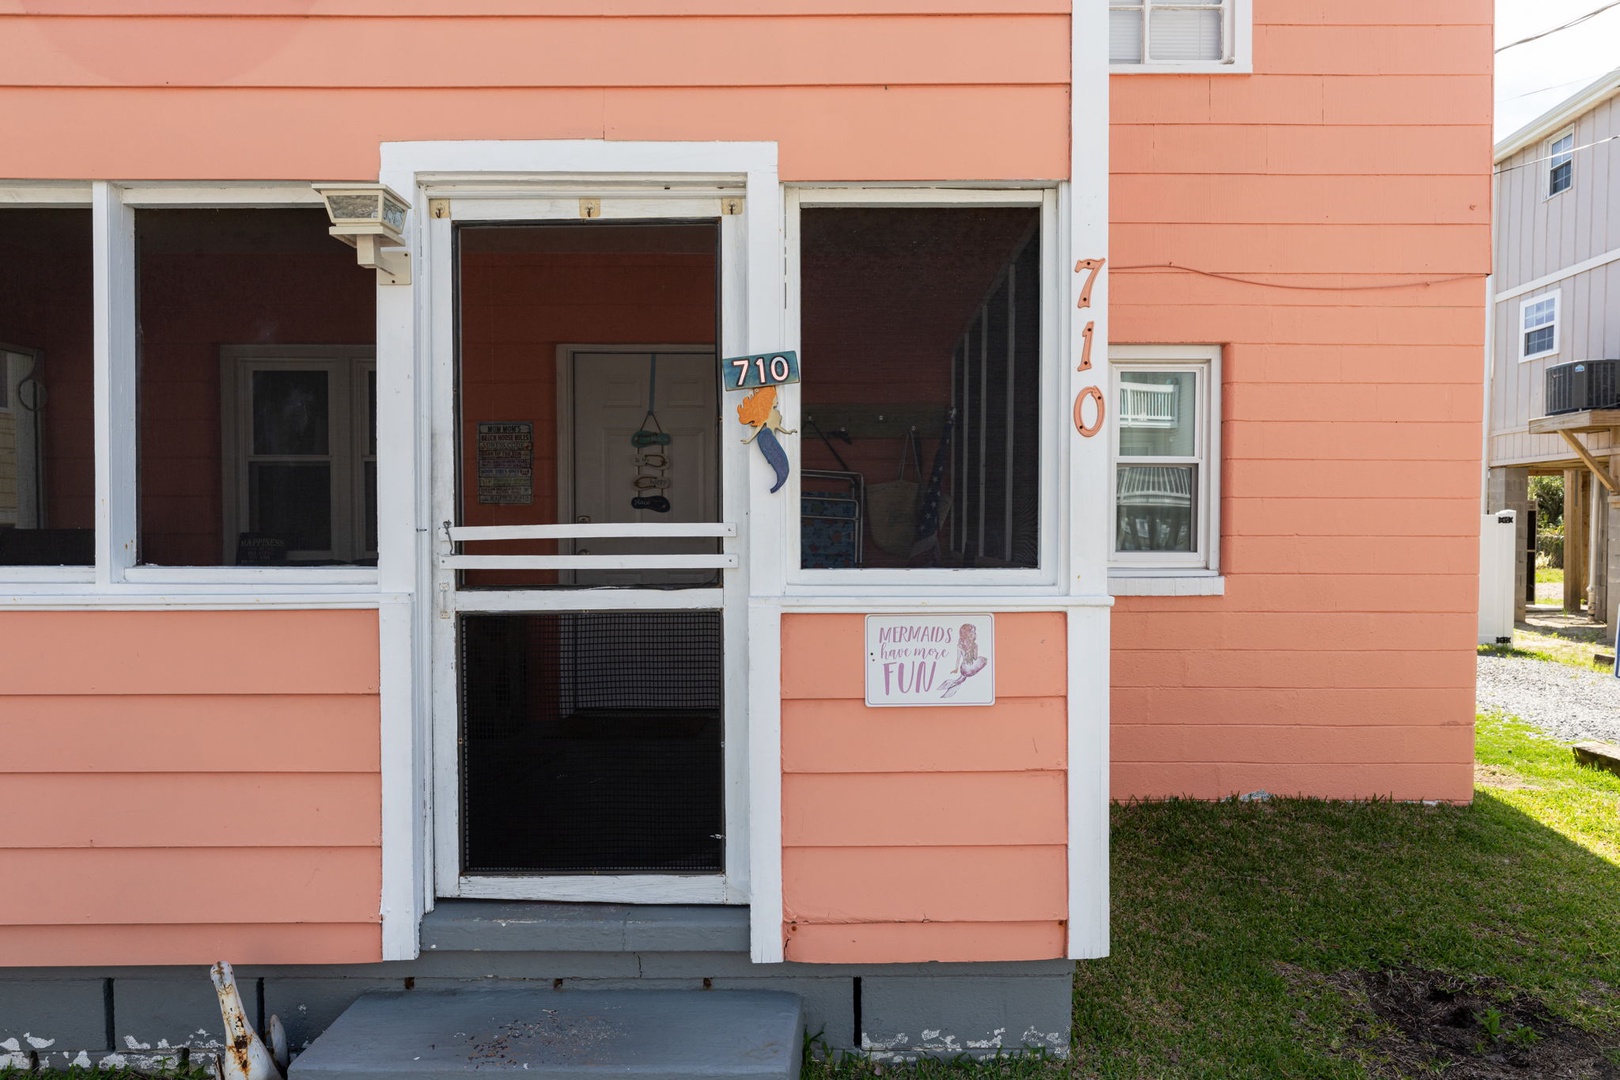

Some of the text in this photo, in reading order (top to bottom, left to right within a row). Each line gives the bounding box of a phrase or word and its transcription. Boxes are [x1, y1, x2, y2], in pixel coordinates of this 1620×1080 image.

[1073, 257, 1106, 438] 710
[732, 355, 789, 386] 710
[487, 425, 521, 433] MOM MOM'S
[241, 538, 284, 547] HAPPINESS
[879, 625, 953, 644] MERMAIDS
[880, 641, 950, 660] have more
[883, 661, 937, 696] FUN
